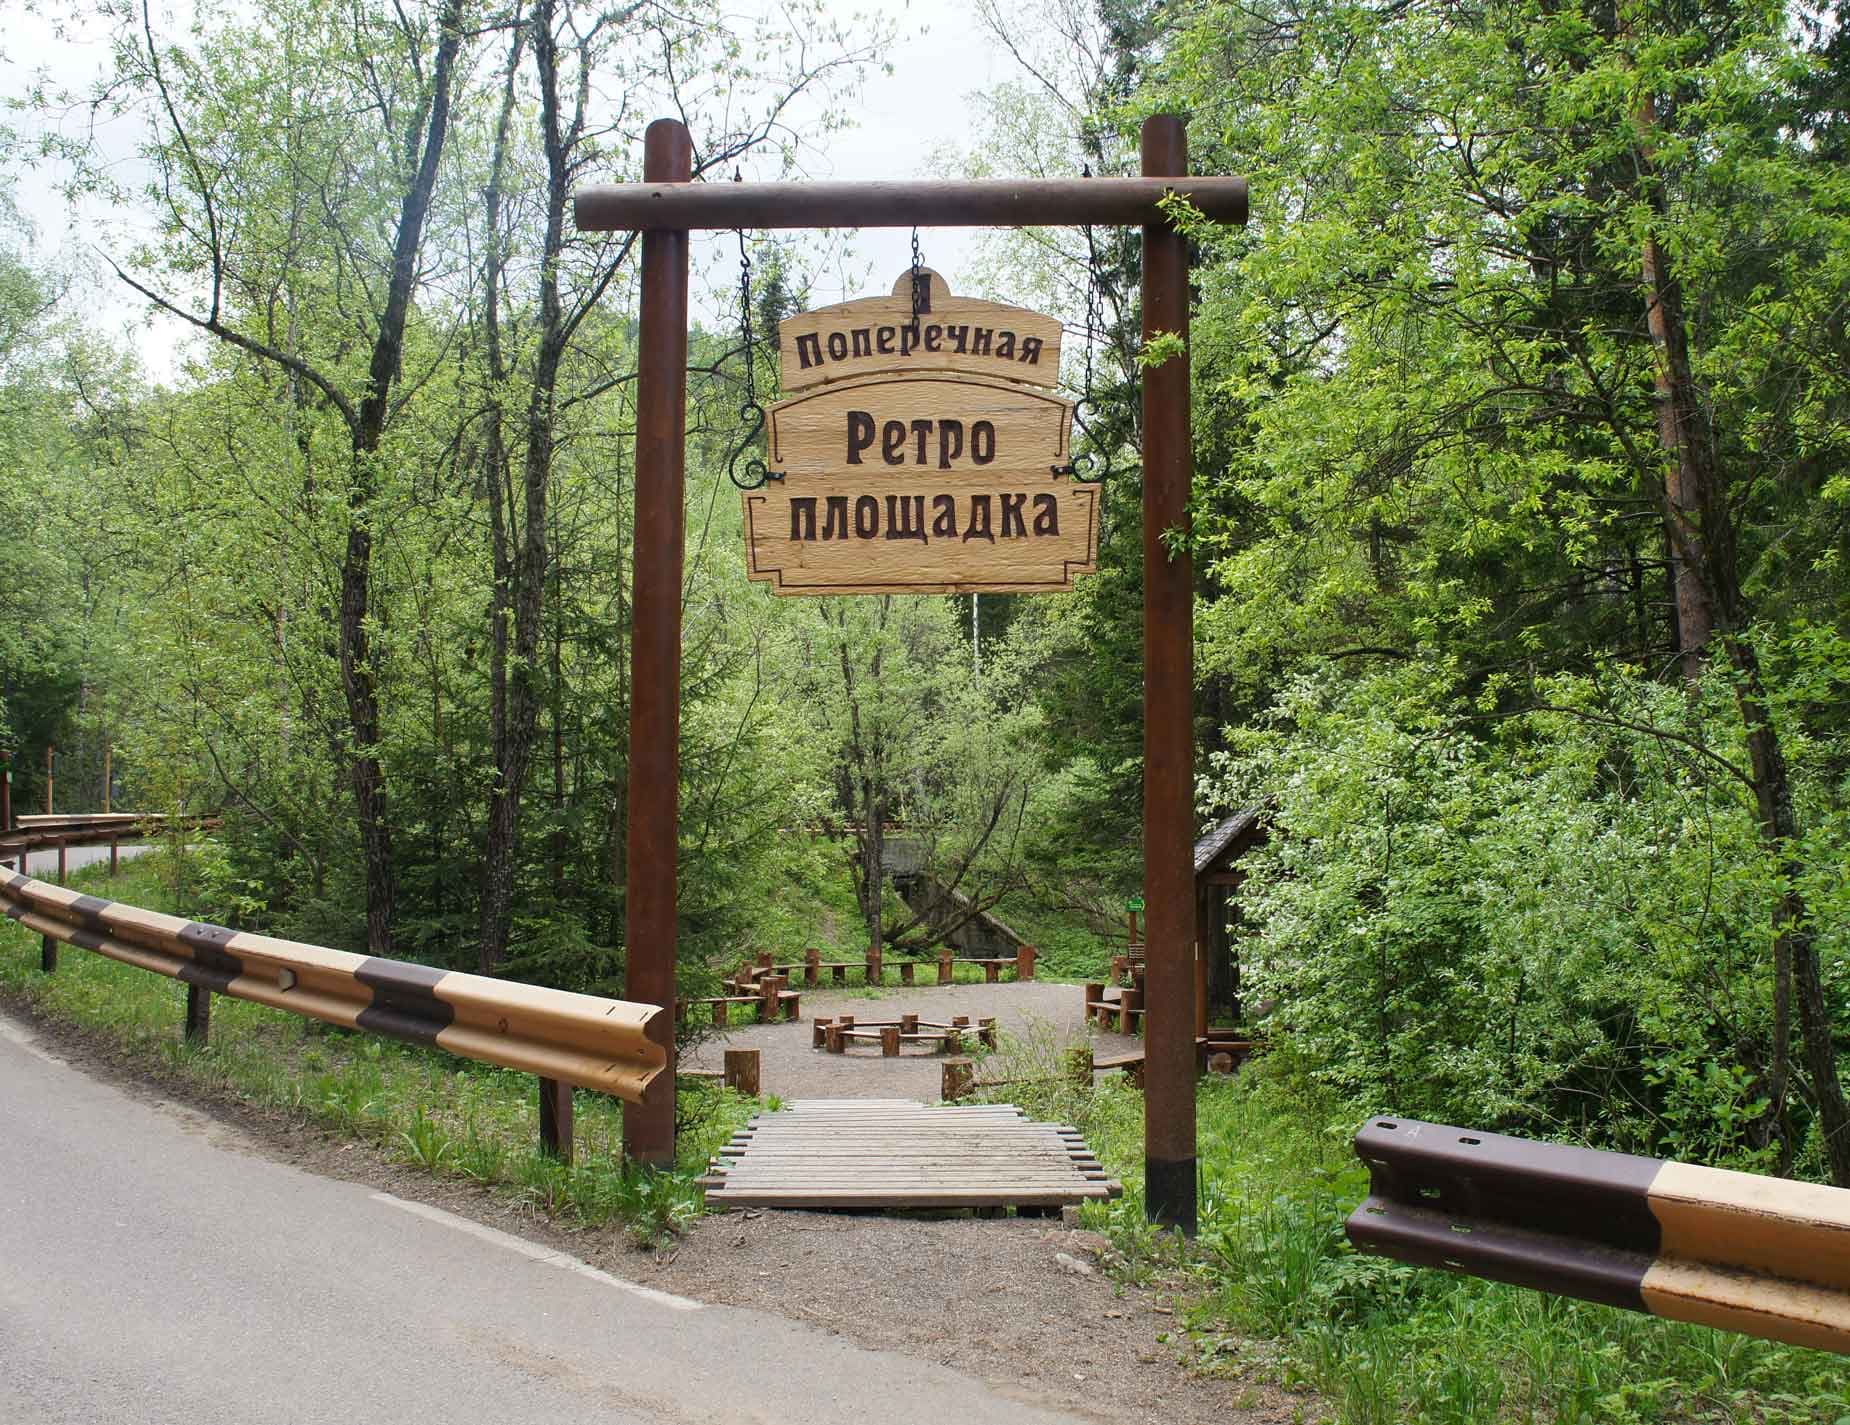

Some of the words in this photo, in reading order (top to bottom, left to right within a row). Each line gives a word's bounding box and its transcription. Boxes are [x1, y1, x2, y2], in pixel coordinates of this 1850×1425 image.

[795, 323, 1044, 370] Поперечная
[846, 410, 996, 470] Ретро
[789, 493, 1060, 546] площадка
